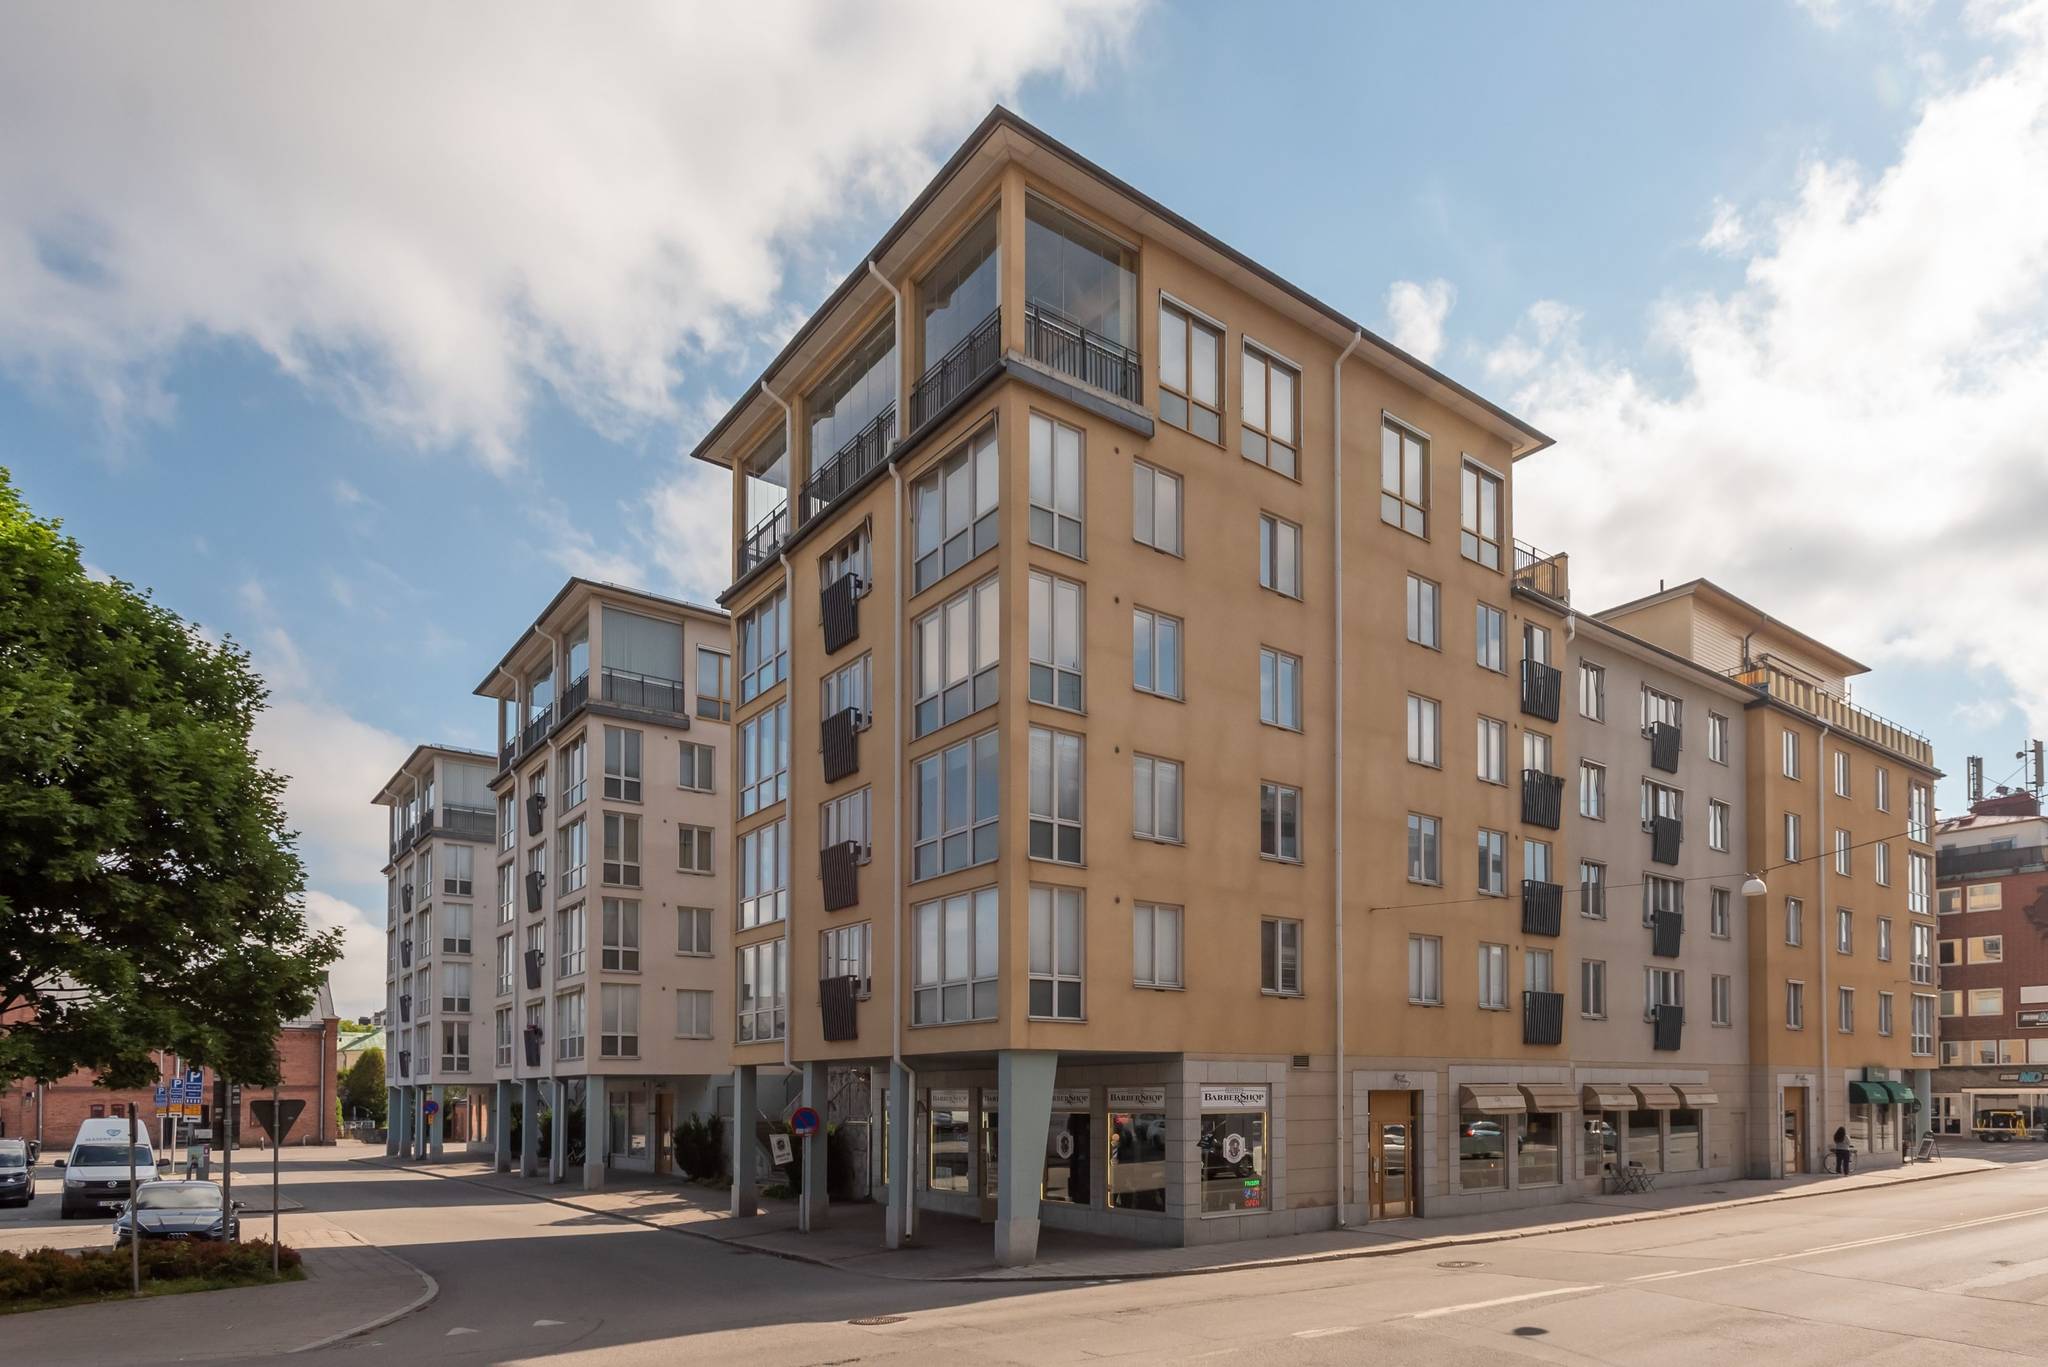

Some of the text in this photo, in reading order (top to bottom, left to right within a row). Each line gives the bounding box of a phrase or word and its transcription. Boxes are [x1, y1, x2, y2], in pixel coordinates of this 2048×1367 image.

[190, 1072, 201, 1082] P
[174, 1079, 182, 1088] P
[158, 1087, 165, 1095] P
[1110, 1094, 1163, 1106] BARBERSHOP
[1204, 1093, 1264, 1105] BARBERSHOP
